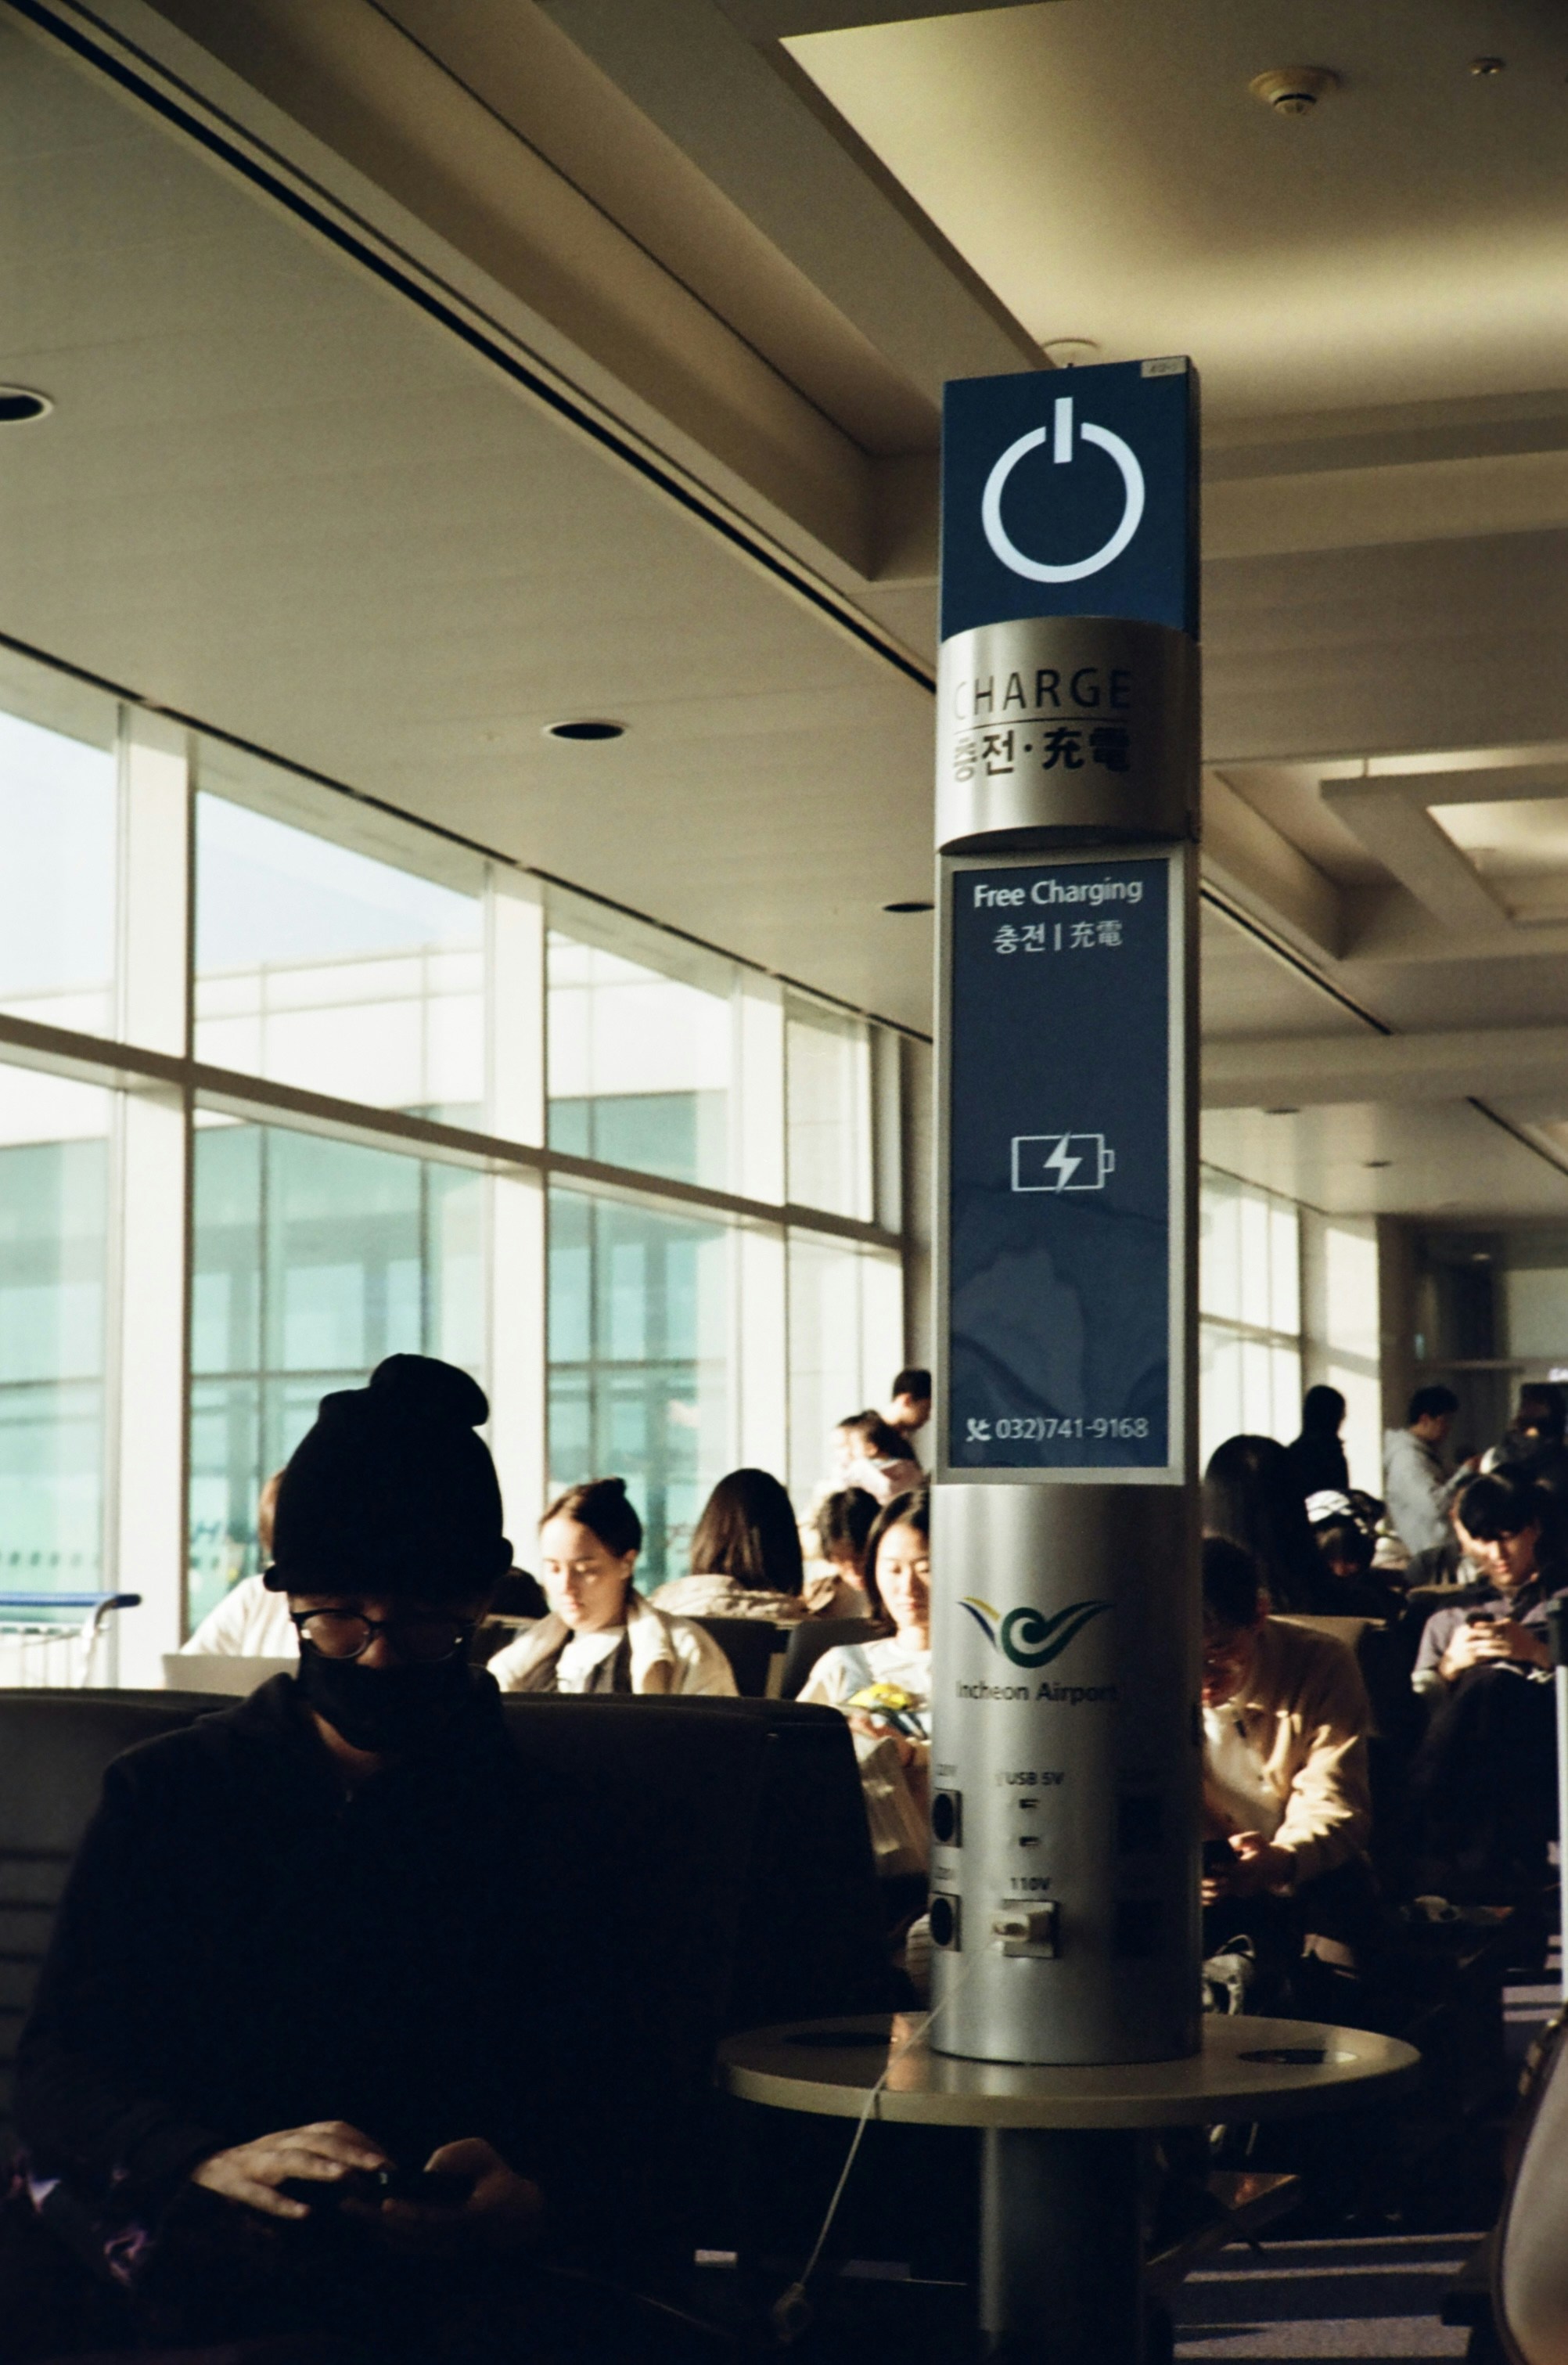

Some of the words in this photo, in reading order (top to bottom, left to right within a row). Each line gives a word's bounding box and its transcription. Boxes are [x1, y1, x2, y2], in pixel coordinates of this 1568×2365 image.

[954, 667, 1131, 720] CHARGE
[973, 884, 1026, 908] Free
[1030, 877, 1143, 905] Charging
[994, 1417, 1149, 1442] 032)741-9168
[955, 1680, 1030, 1701] Incheon
[1005, 1771, 1038, 1786] USB
[1041, 1771, 1065, 1786] 5V
